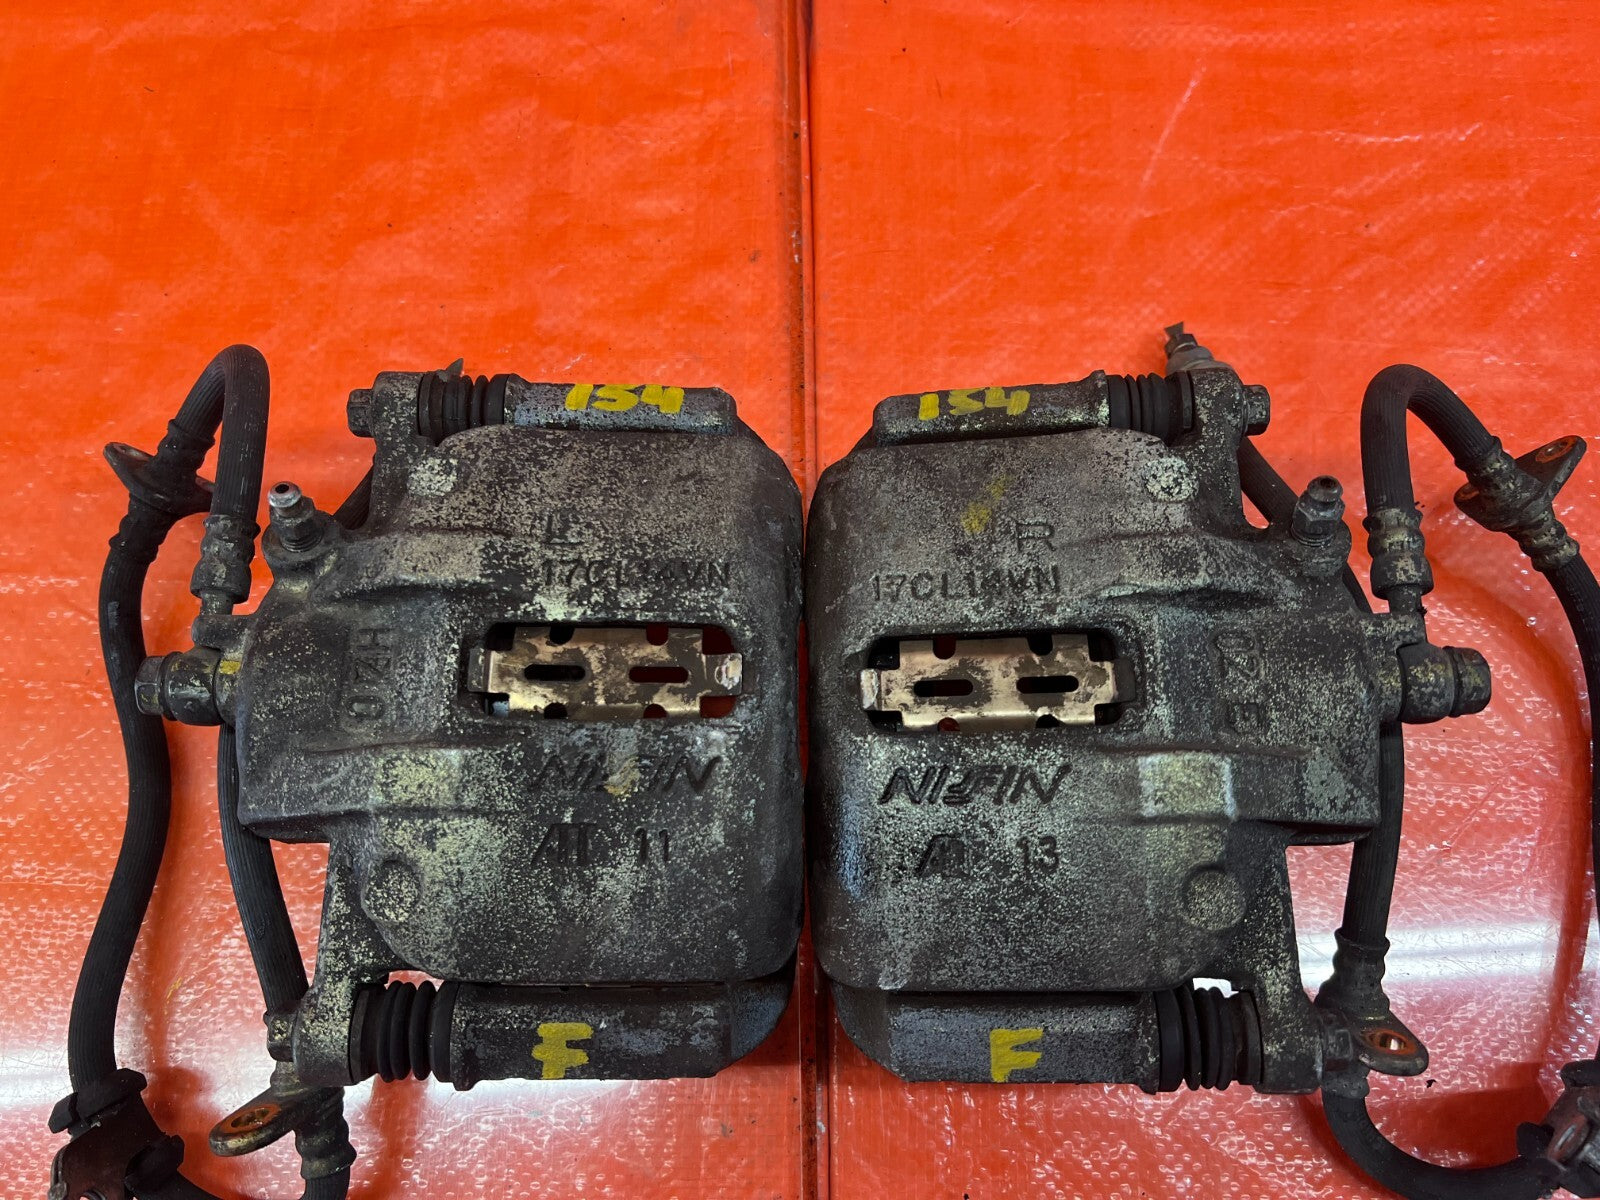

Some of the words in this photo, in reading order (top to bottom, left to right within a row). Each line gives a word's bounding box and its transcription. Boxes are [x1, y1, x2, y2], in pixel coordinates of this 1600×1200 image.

[1015, 520, 1057, 551] R
[531, 1021, 594, 1079] F
[989, 1027, 1044, 1083] F
